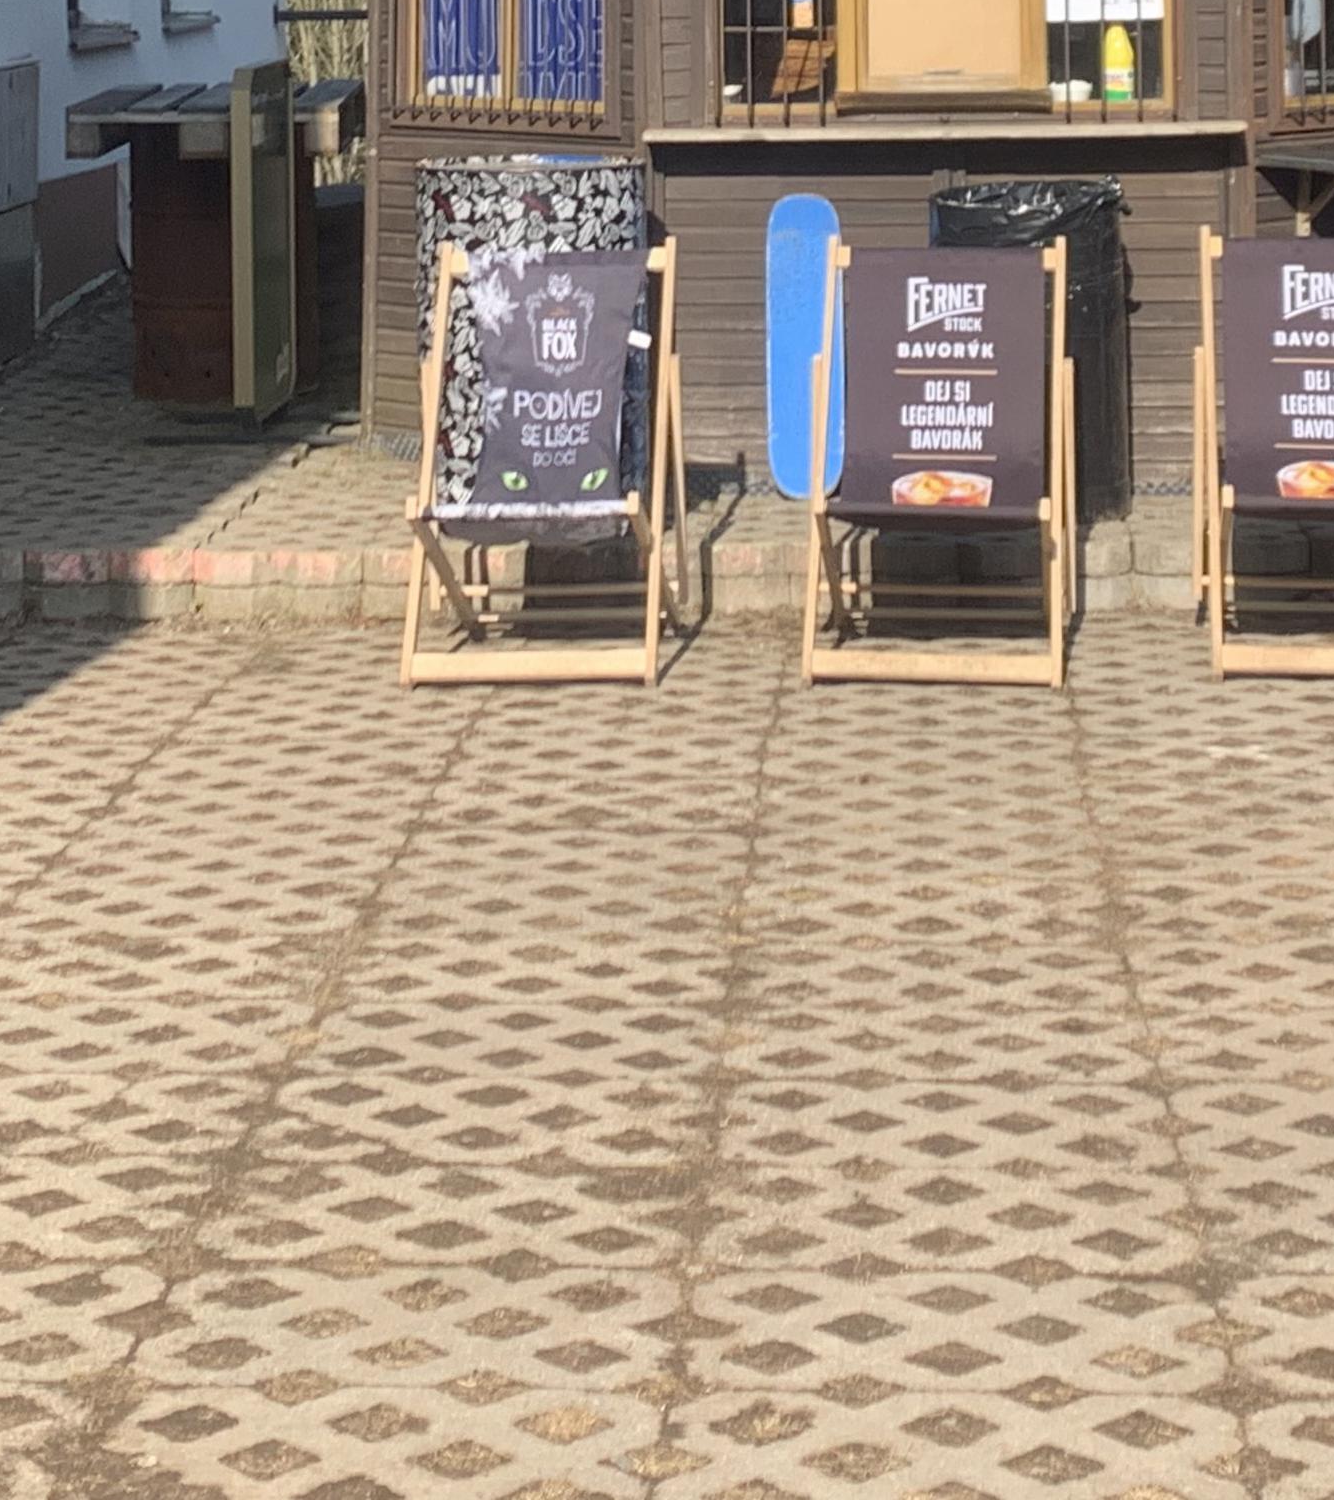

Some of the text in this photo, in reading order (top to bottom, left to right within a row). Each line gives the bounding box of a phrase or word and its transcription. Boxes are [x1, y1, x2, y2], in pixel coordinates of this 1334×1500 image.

[907, 276, 987, 333] FERNET
[542, 318, 578, 333] BLACK
[944, 316, 983, 332] STOCK
[542, 331, 578, 360] FOX
[925, 380, 971, 403] DEJ SI
[1303, 369, 1331, 391] DEJ
[513, 387, 603, 420] PODÍVEJ
[901, 402, 994, 428] LEGENDÁRNÍ
[521, 422, 542, 447] SE
[910, 427, 983, 451] BAVORÁK
[532, 451, 553, 468] DO
